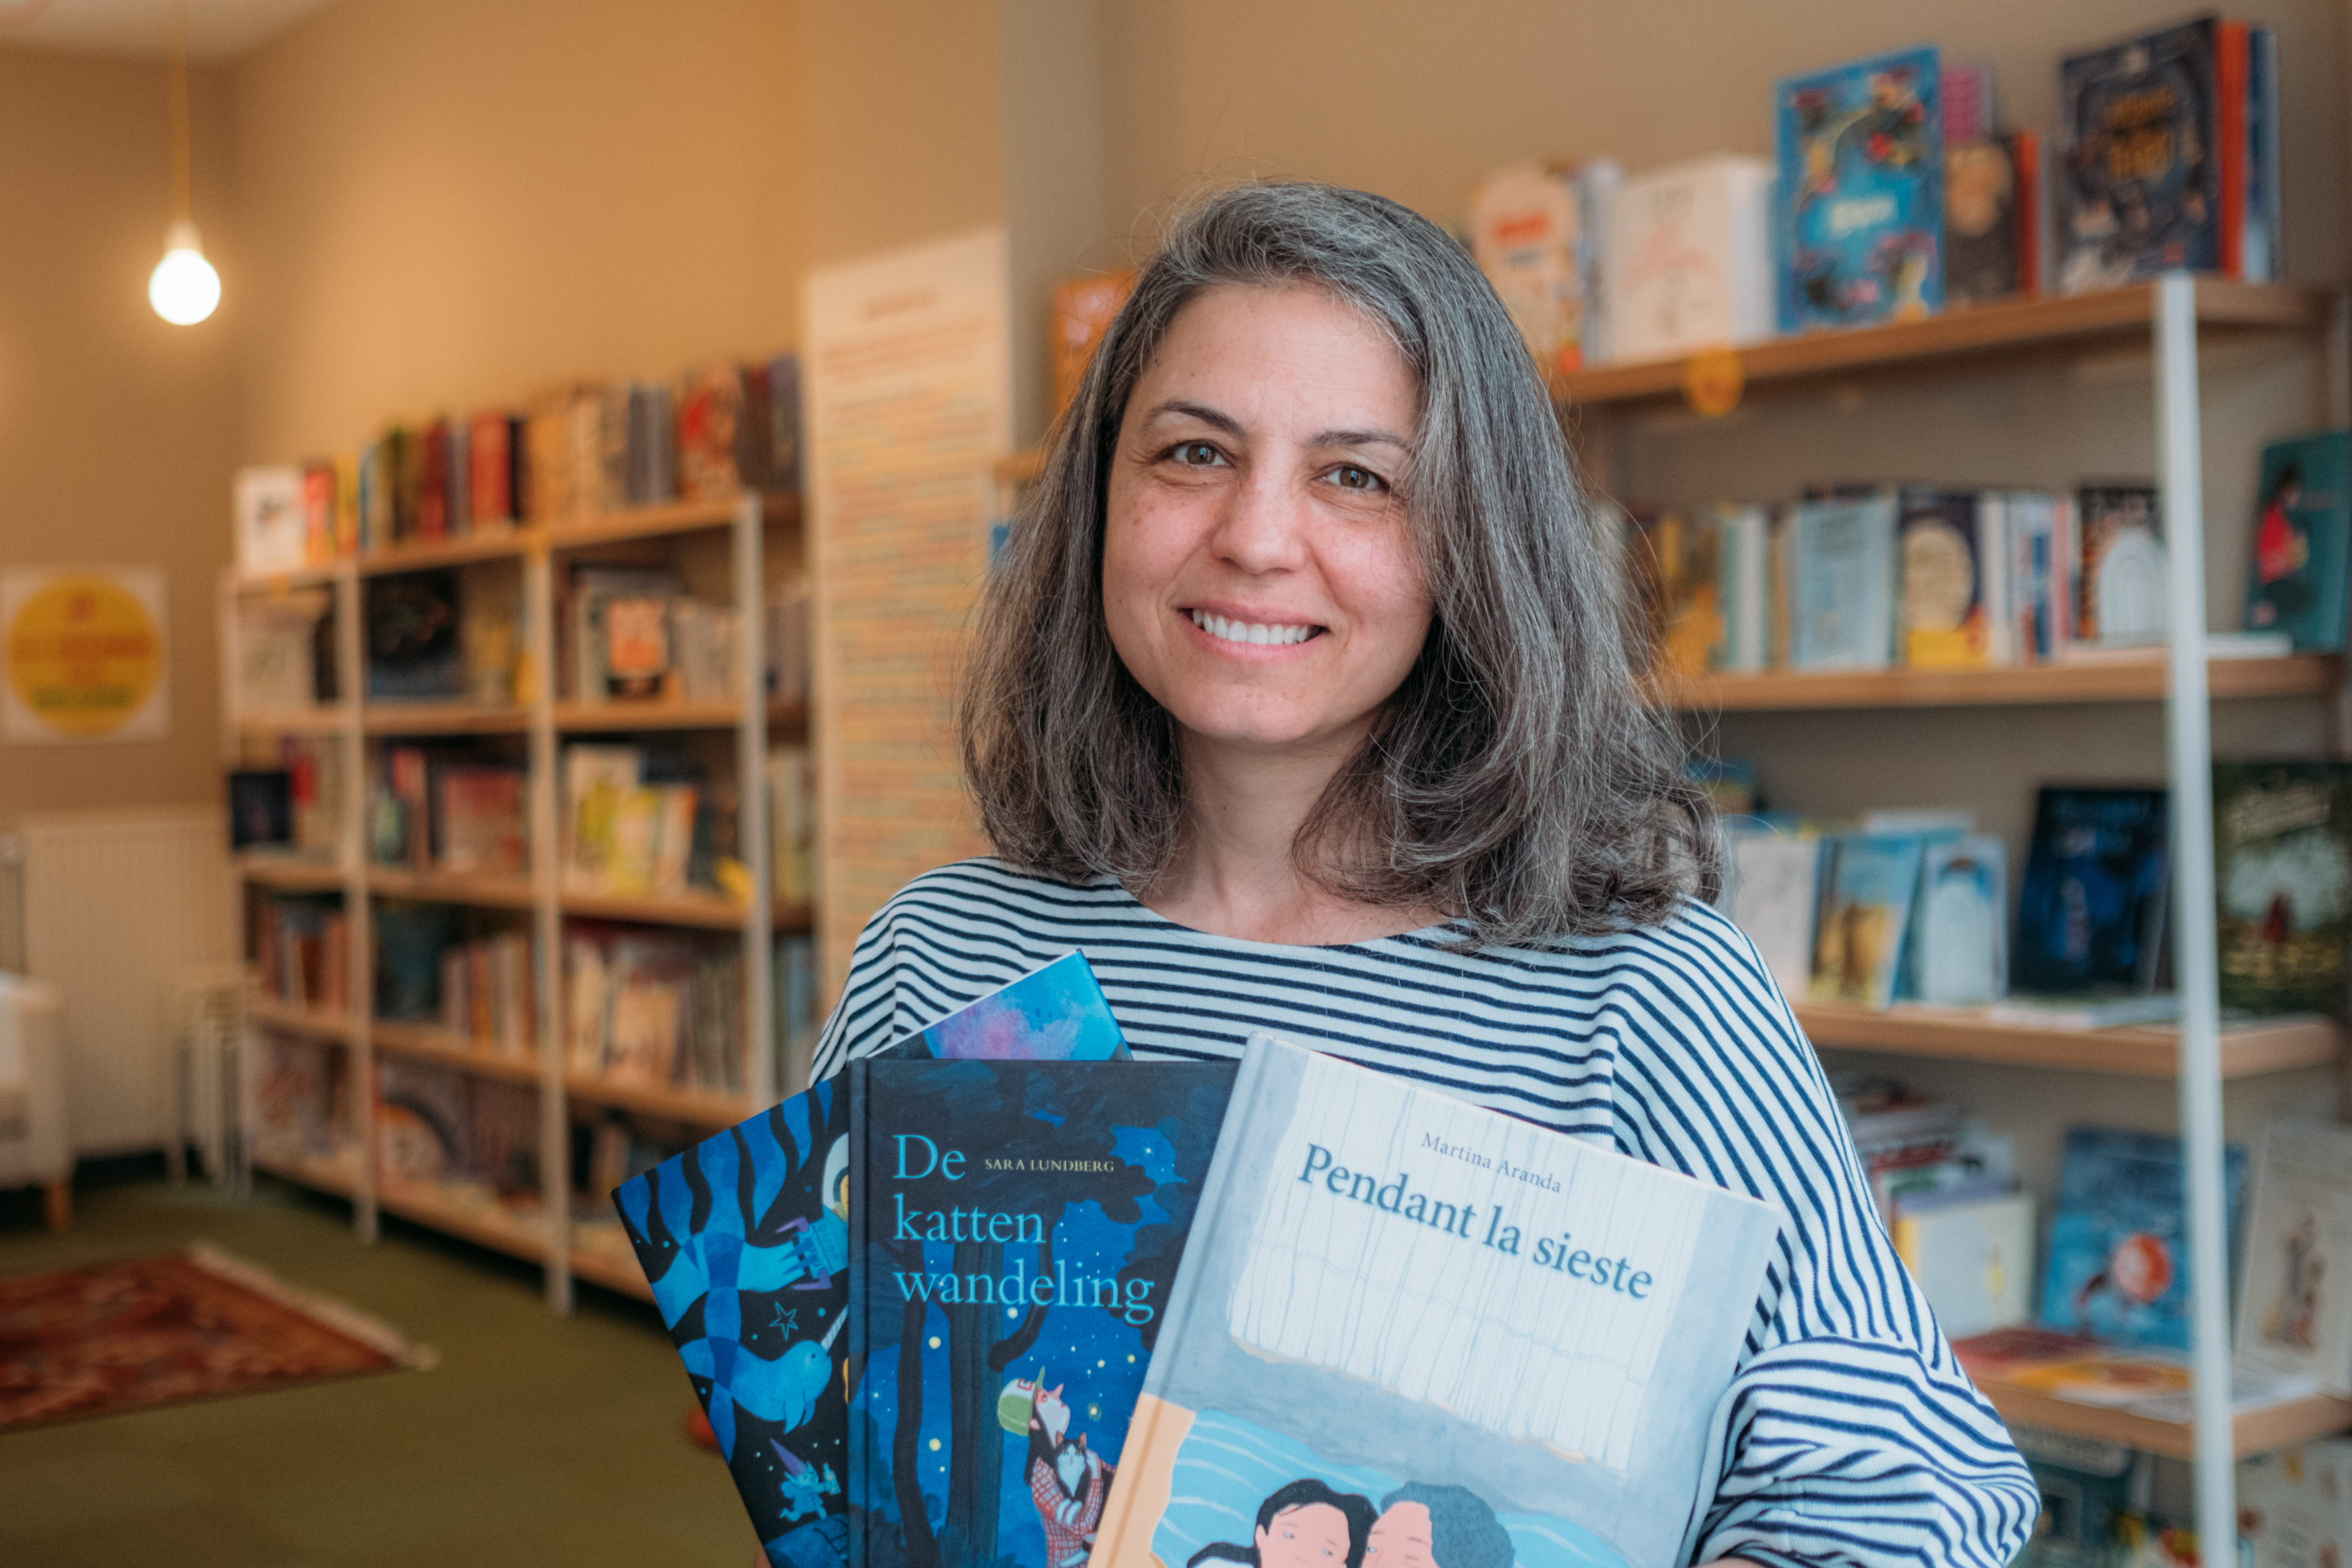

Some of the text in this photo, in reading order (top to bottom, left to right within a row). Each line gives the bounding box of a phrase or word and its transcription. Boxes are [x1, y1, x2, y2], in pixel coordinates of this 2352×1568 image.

[893, 1134, 966, 1180] De
[984, 1158, 1115, 1172] SARA LUNDBERG
[1421, 1132, 1562, 1193] Martina Aranda
[893, 1193, 1047, 1244] katten
[1296, 1142, 1653, 1299] Pendant la sieste
[893, 1258, 1155, 1325] wandeling
